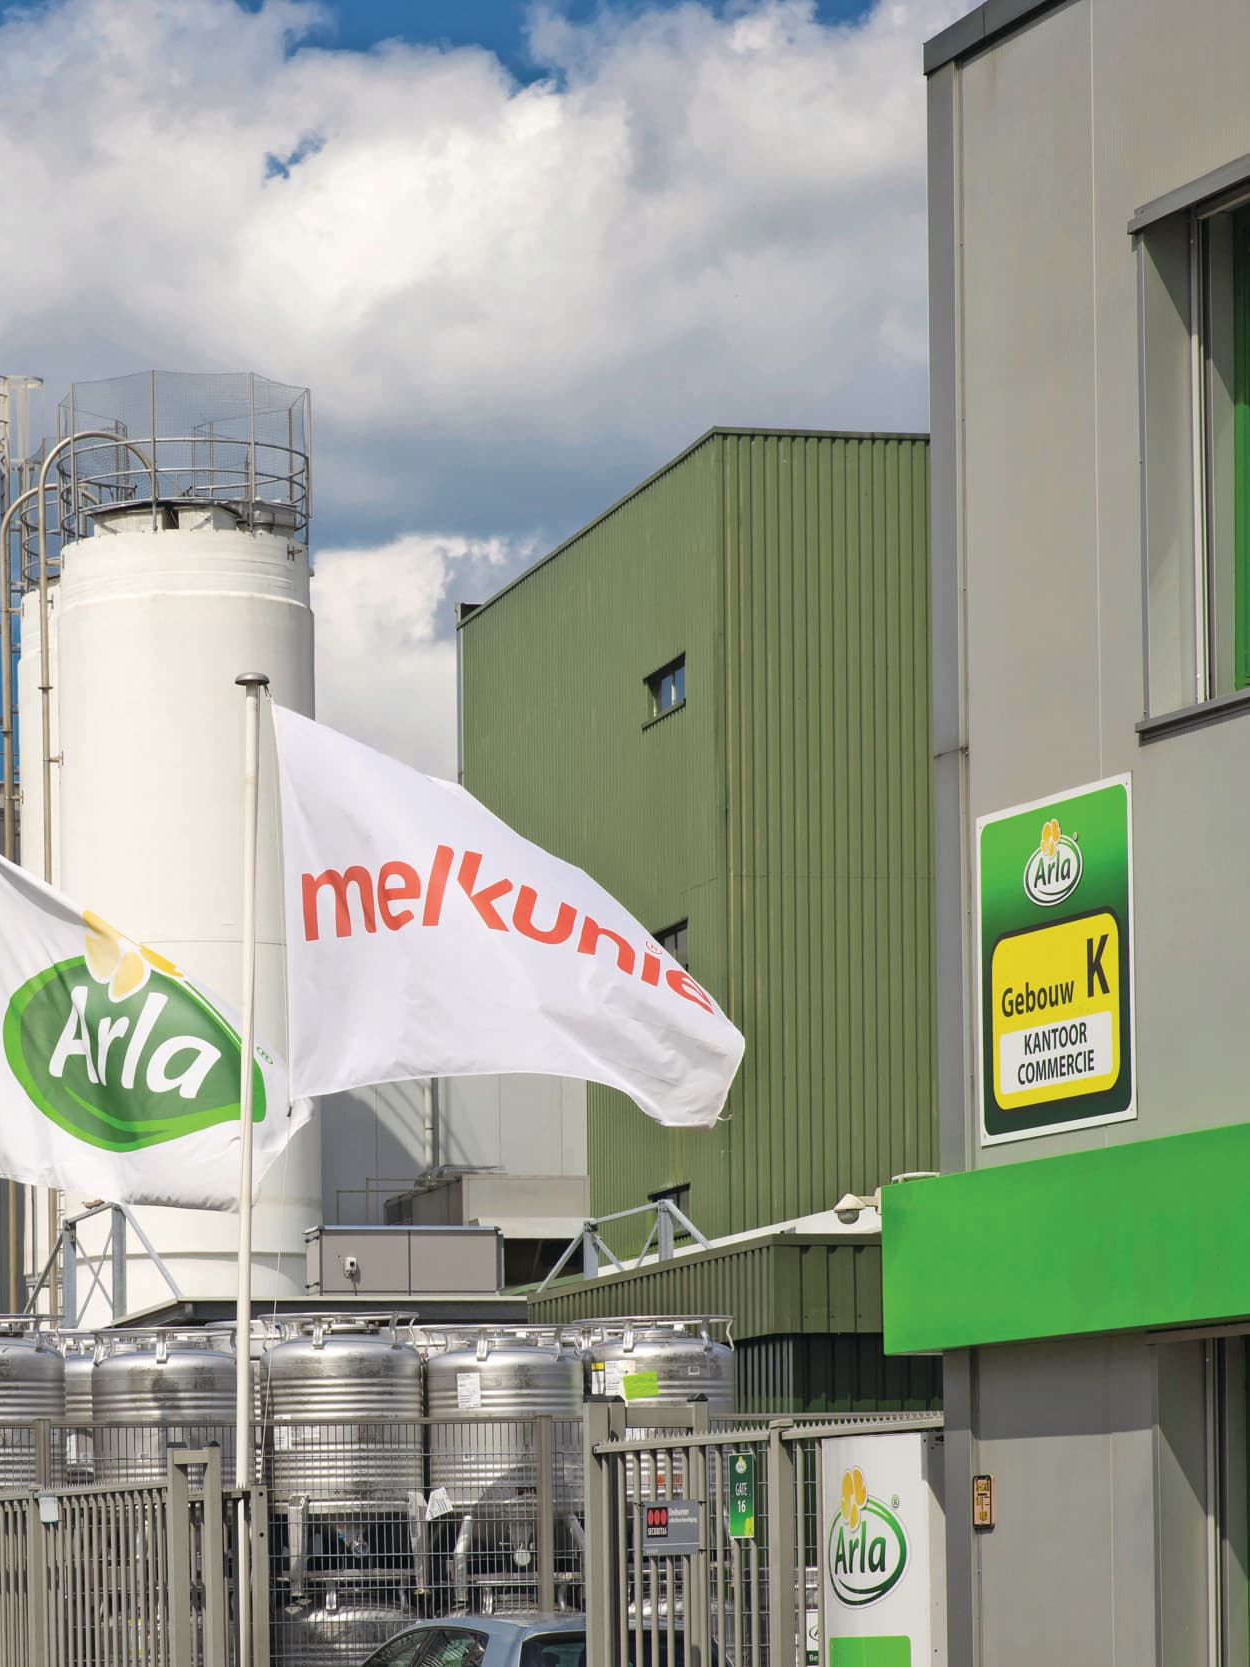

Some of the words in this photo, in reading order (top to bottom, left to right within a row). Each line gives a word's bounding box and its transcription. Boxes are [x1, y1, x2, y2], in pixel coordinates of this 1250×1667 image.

[1034, 850, 1072, 889] Arla
[301, 844, 716, 1015] melkunie
[1001, 980, 1075, 1018] Gebouw
[1086, 933, 1111, 998] K
[49, 985, 222, 1099] Arla
[1024, 1022, 1088, 1056] KANTOOR
[1017, 1049, 1095, 1086] COMMERCIE
[735, 1482, 748, 1496] GATE
[737, 1500, 746, 1513] 16
[835, 1520, 887, 1575] Arla
